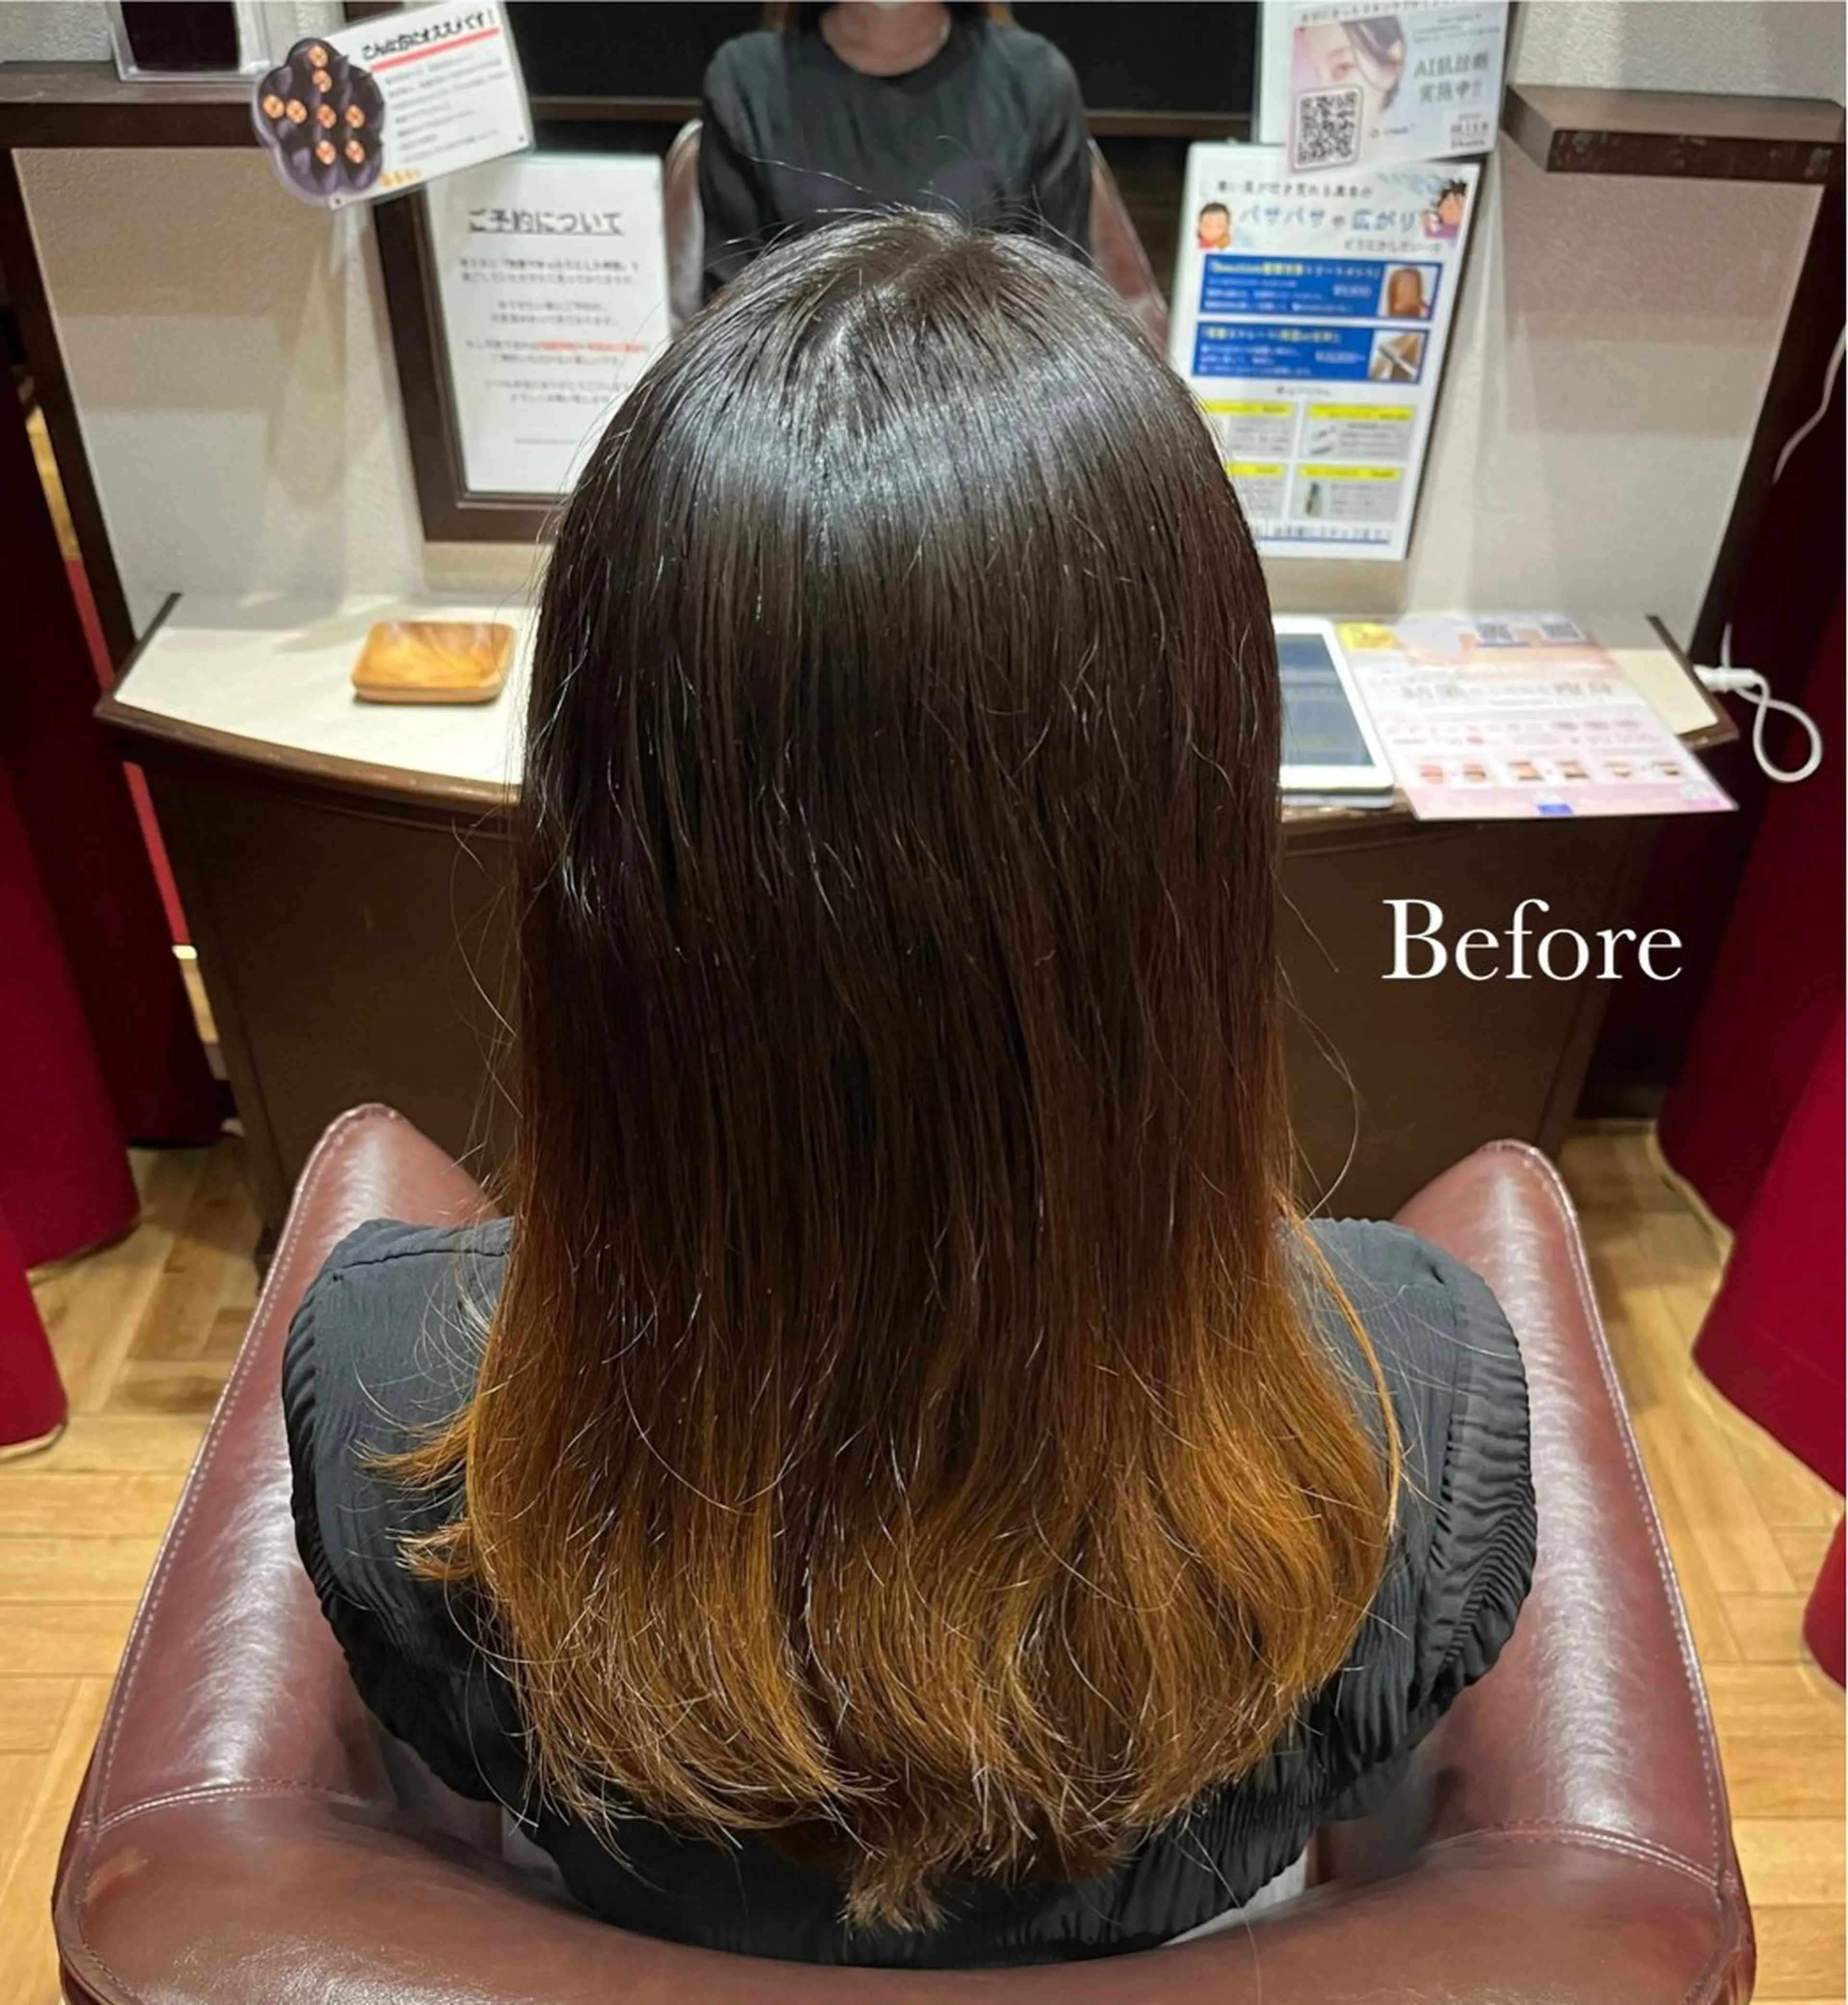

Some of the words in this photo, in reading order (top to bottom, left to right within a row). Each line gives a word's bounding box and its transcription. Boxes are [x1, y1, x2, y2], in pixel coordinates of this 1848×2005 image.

[468, 207, 623, 233] ご予約について
